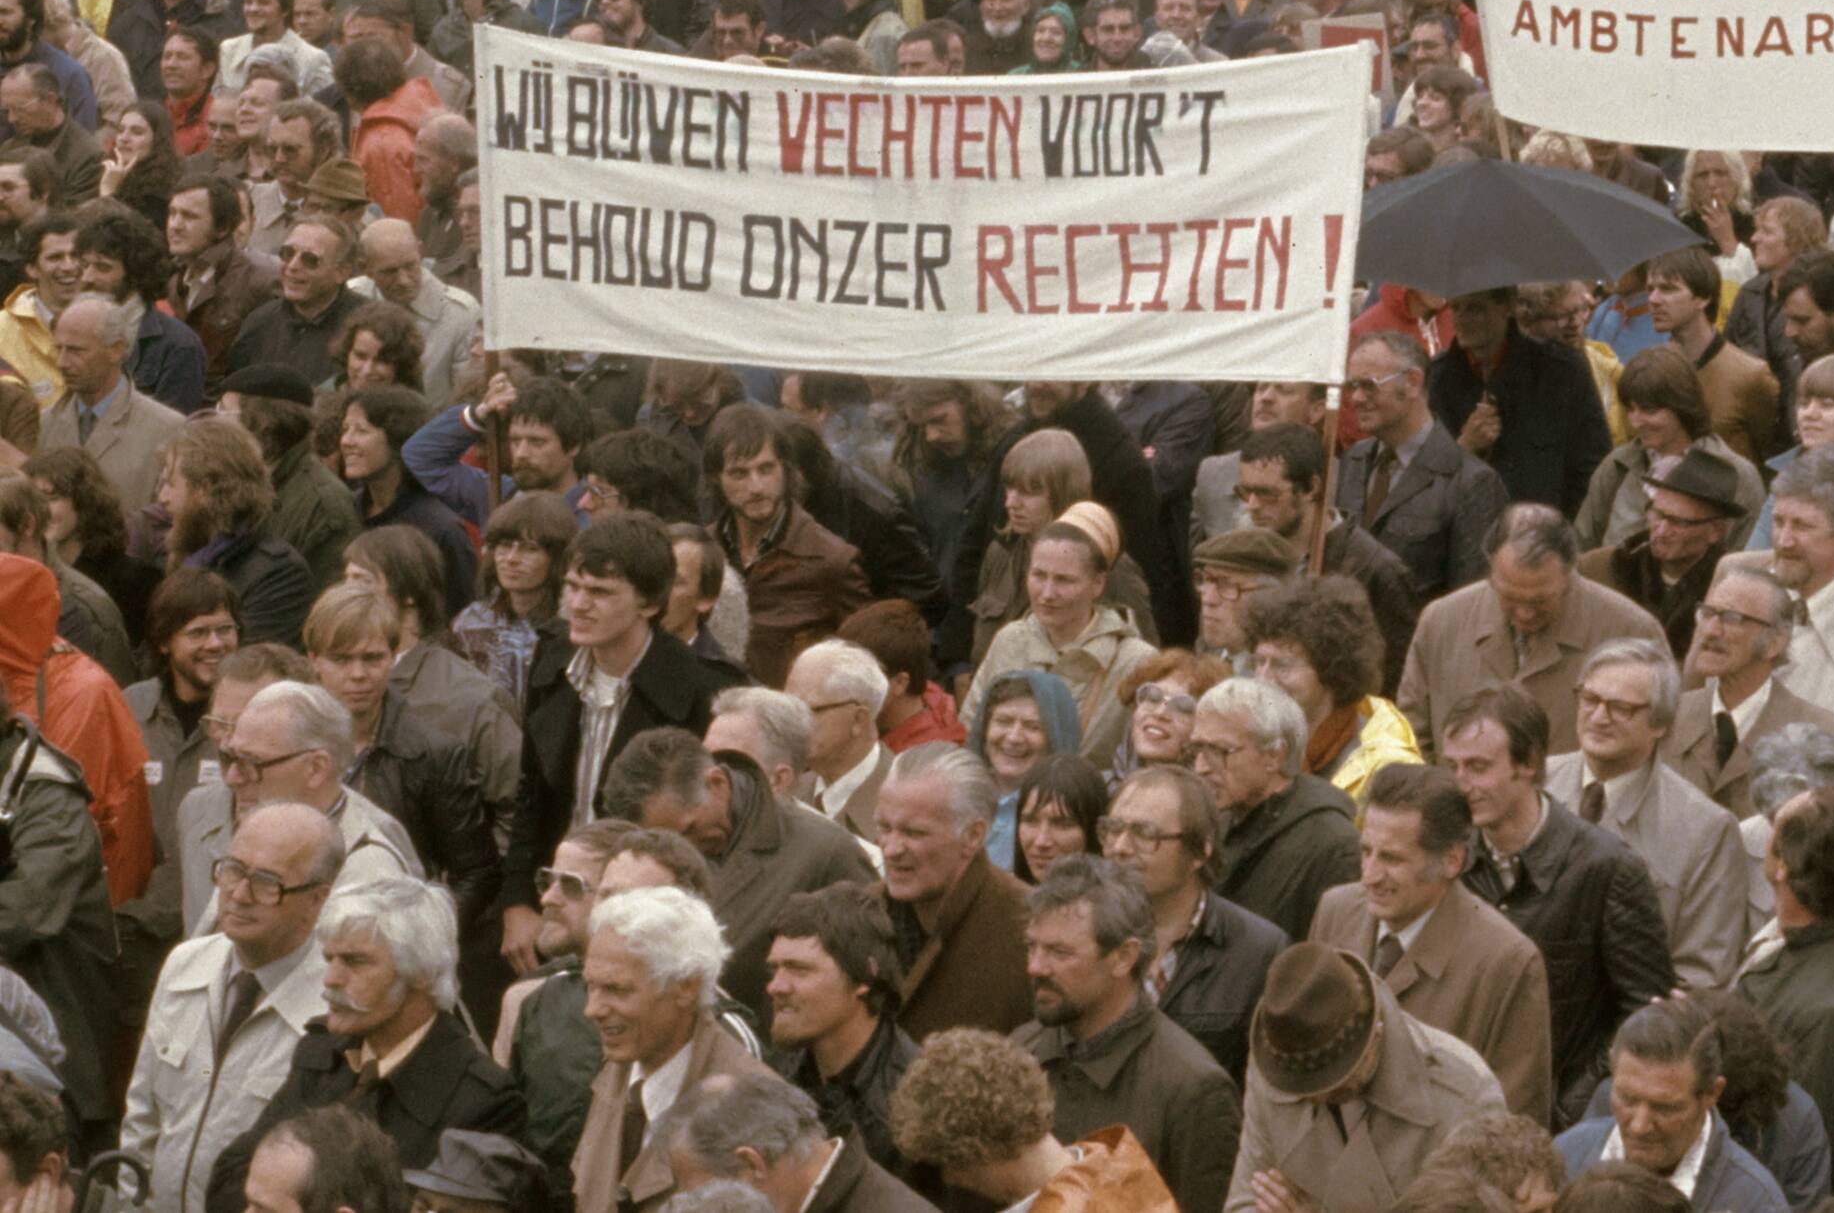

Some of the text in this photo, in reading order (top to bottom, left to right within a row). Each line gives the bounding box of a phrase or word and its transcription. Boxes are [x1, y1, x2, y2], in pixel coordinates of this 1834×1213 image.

[777, 90, 1022, 179] VECHTEN
[1040, 90, 1165, 178] VOOR
[503, 195, 718, 292] BEHOUD
[740, 213, 952, 312] ONZER
